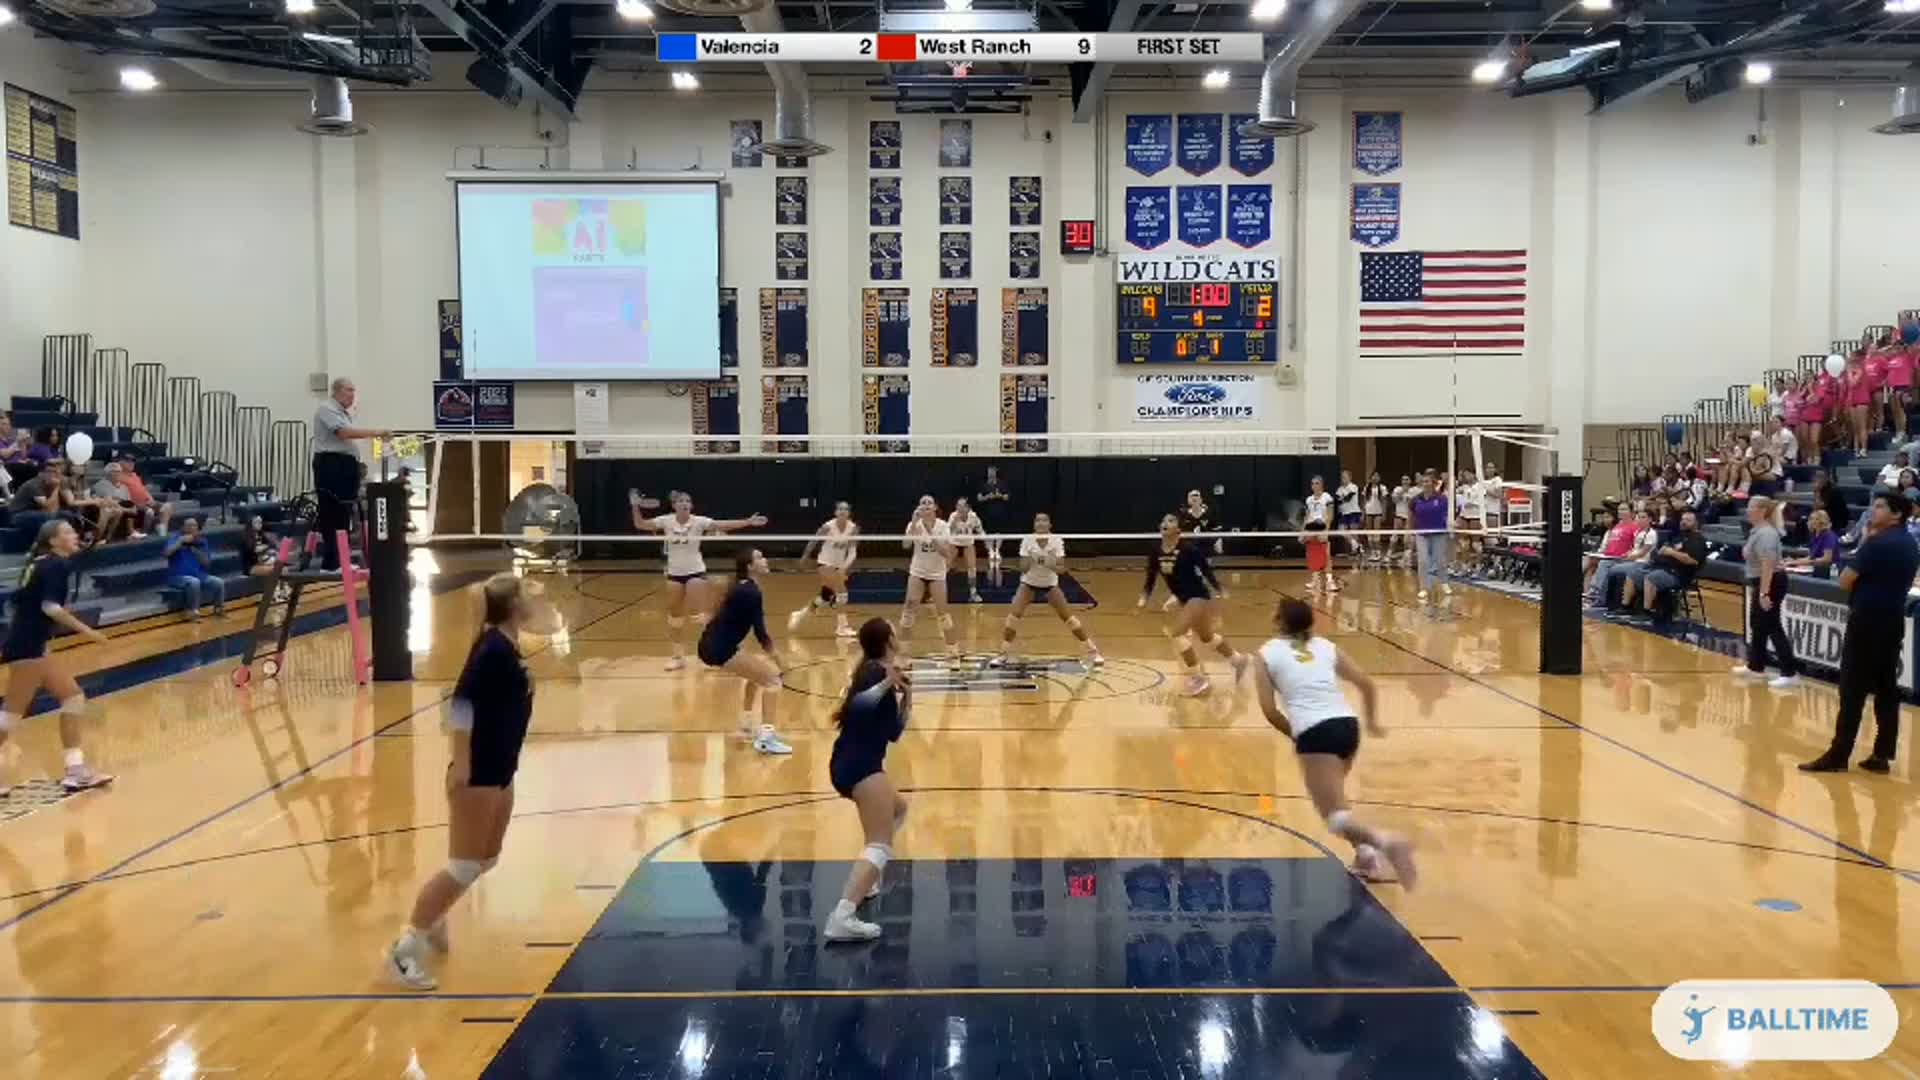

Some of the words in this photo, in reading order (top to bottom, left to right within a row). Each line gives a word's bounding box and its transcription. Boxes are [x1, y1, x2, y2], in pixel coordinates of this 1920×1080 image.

[1064, 222, 1091, 243] 30
[1120, 261, 1275, 281] WILDCATS
[1143, 296, 1155, 317] 9
[1258, 295, 1271, 317] 2
[1137, 406, 1253, 417] CHAMPIONSHIPS
